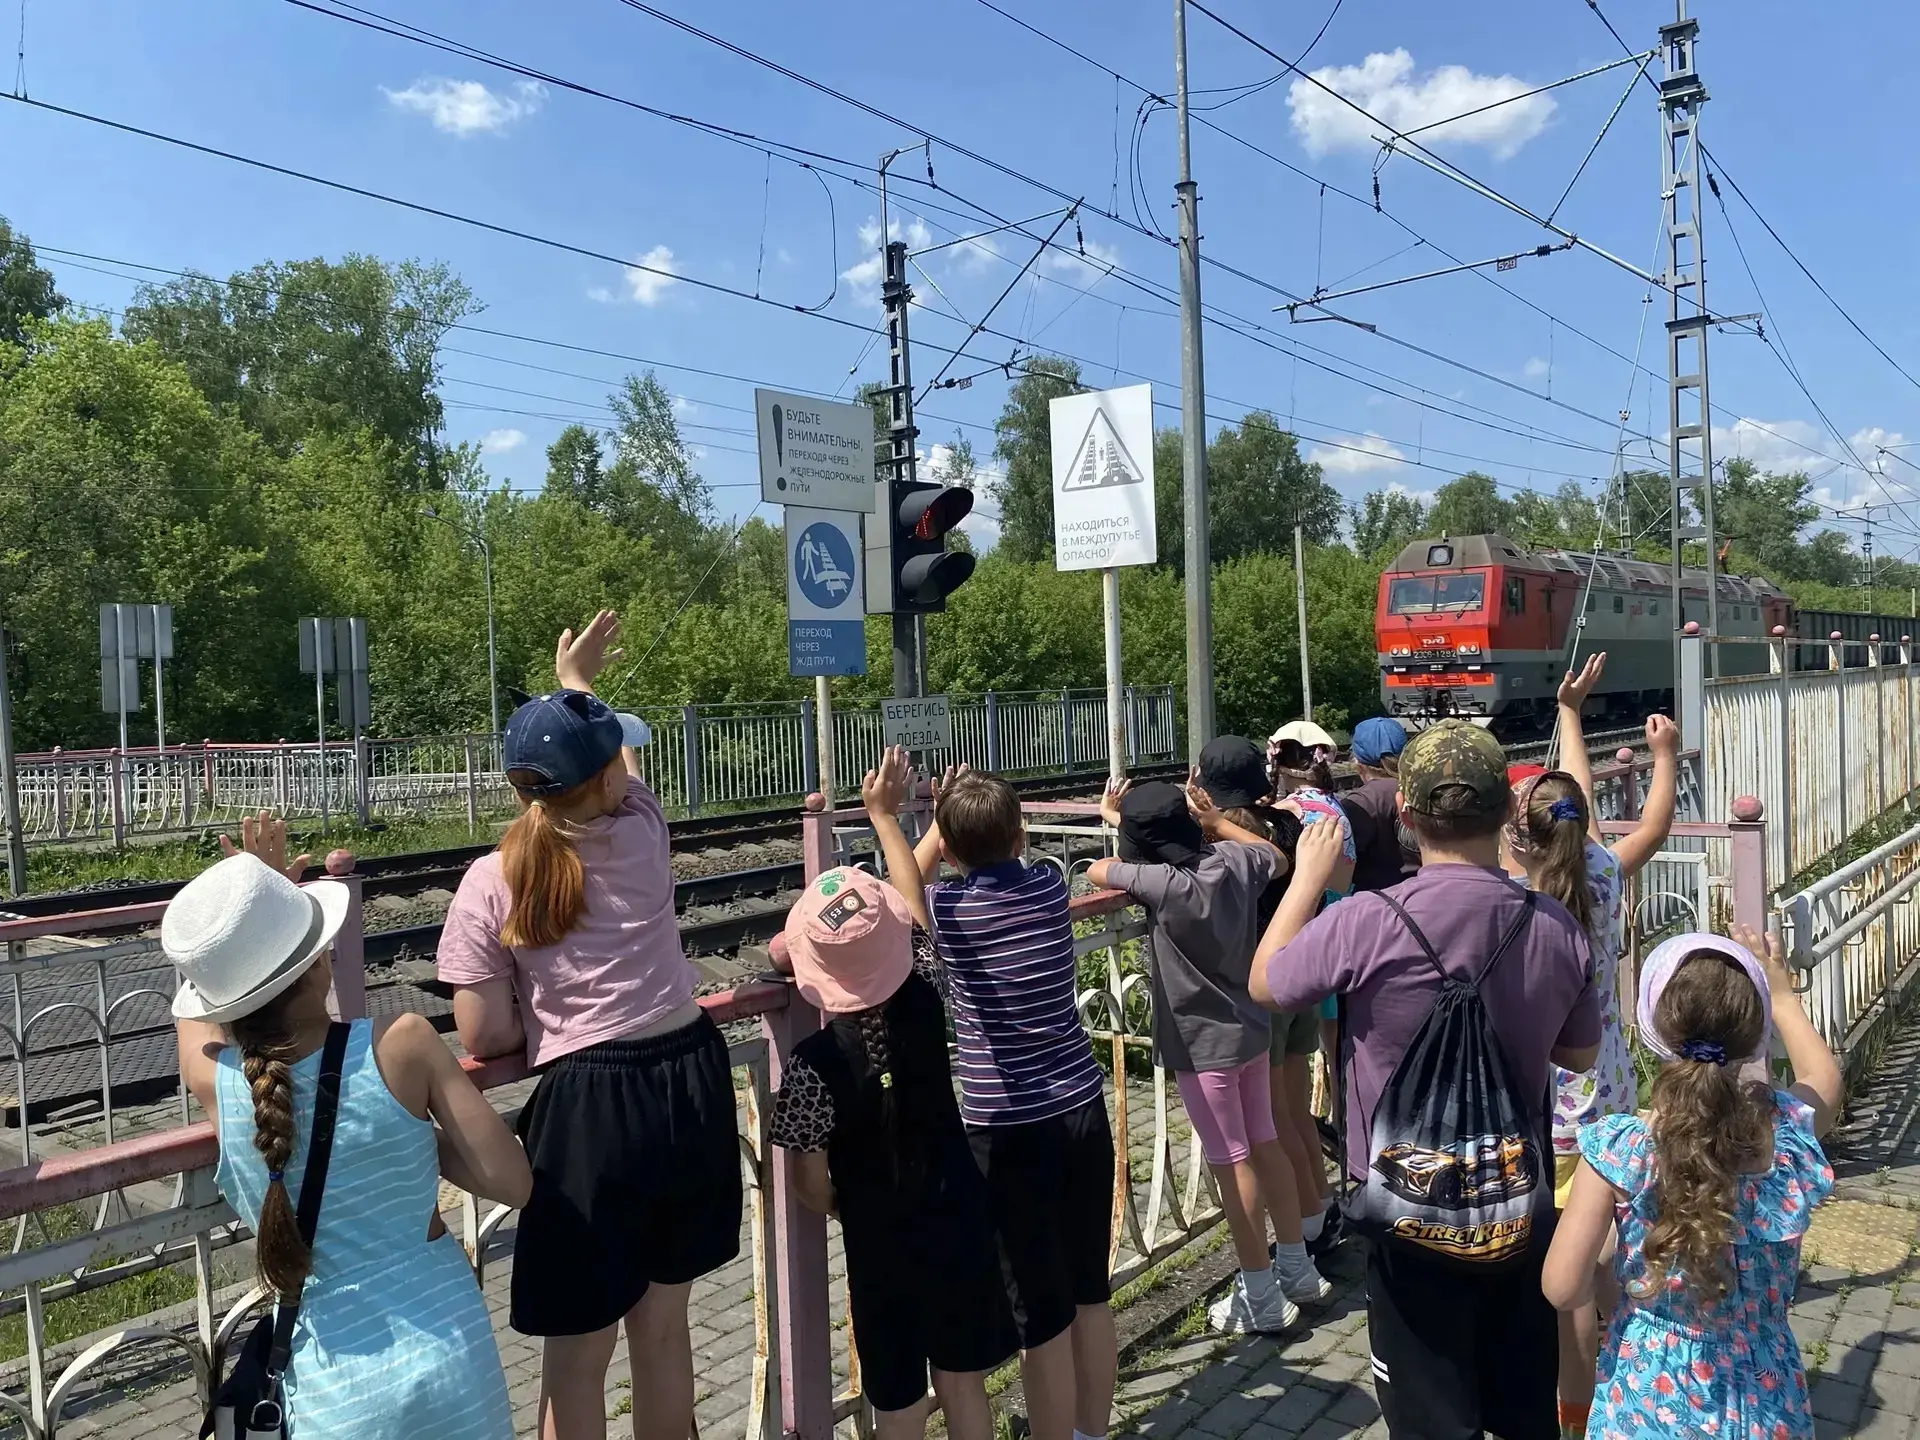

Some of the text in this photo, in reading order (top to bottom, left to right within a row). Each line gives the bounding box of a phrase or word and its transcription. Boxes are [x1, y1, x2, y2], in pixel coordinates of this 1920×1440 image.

[1498, 259, 1516, 271] 529
[786, 408, 821, 425] БУДЬТЕ
[787, 428, 863, 452] ВНИМАТЕЛЬНЫ,
[788, 448, 849, 466] ПЕРЕХОДЯ ЧЕРЕЗ
[789, 465, 866, 484] ЖЕЛЕЗНОДОРОЖНЫЕ
[790, 483, 811, 494] ПУТИ
[1061, 516, 1130, 533] НАХОДИТЬСЯ
[1062, 529, 1141, 547] В МЕЖДУПУТЬЕ
[1062, 547, 1111, 562] ОПАСНО!
[795, 628, 833, 639] ПЕРЕХОД
[795, 642, 820, 652] ЧЕРЕЗ
[796, 656, 836, 668] Ж/Д ПУТИ
[886, 702, 945, 720] БЕРЕГИСЬ
[896, 730, 941, 747] ПОЕЗДА
[1394, 1217, 1476, 1244] STREET
